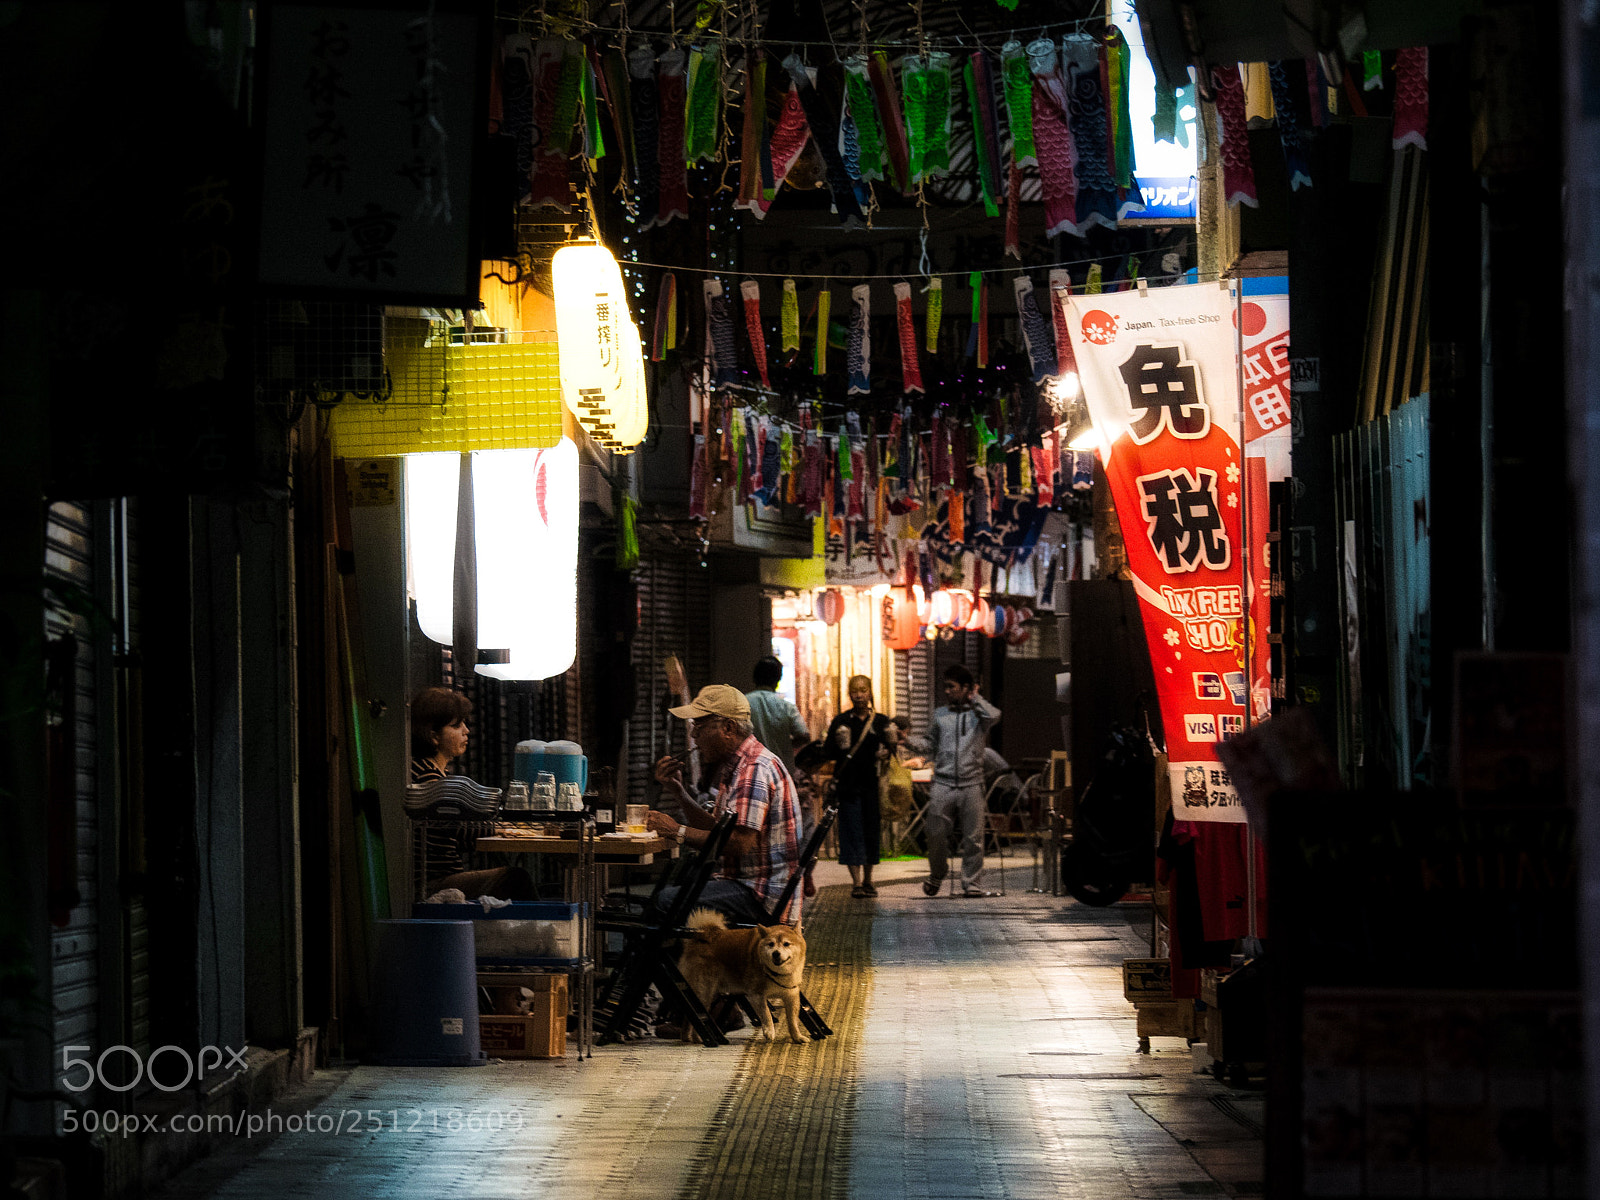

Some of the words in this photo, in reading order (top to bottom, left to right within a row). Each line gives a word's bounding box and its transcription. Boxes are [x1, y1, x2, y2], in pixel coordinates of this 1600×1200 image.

[1124, 319, 1156, 331] Japan.
[1158, 316, 1197, 328] Tax-free
[1198, 313, 1221, 326] Shop
[1117, 340, 1230, 574] 免税
[1196, 587, 1242, 616] FREE
[1186, 620, 1229, 650] SHO
[1187, 722, 1216, 735] VISA
